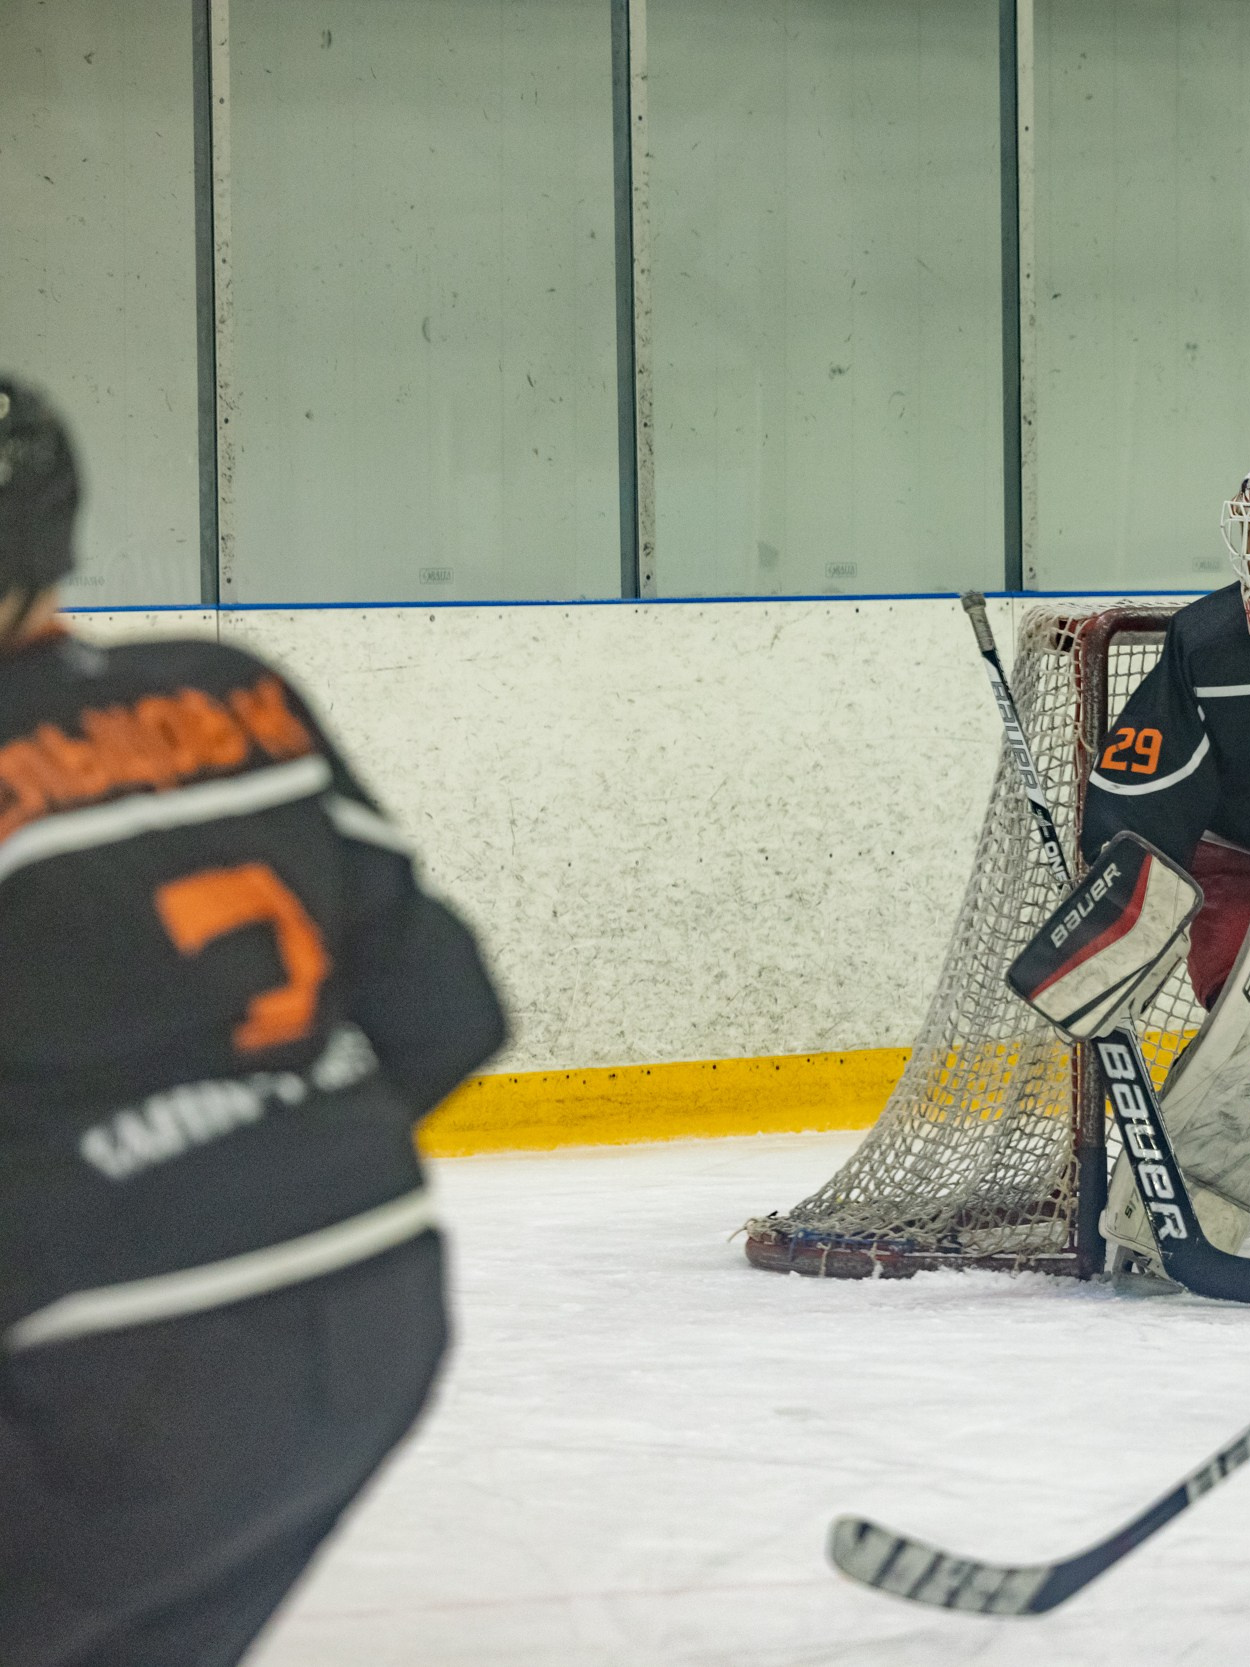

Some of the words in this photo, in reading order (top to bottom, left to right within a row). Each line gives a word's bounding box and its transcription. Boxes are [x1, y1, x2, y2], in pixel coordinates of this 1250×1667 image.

[1100, 727, 1163, 775] 29
[1044, 841, 1069, 885] ONE
[1050, 862, 1122, 948] BAUER
[1098, 1042, 1188, 1240] BAUER
